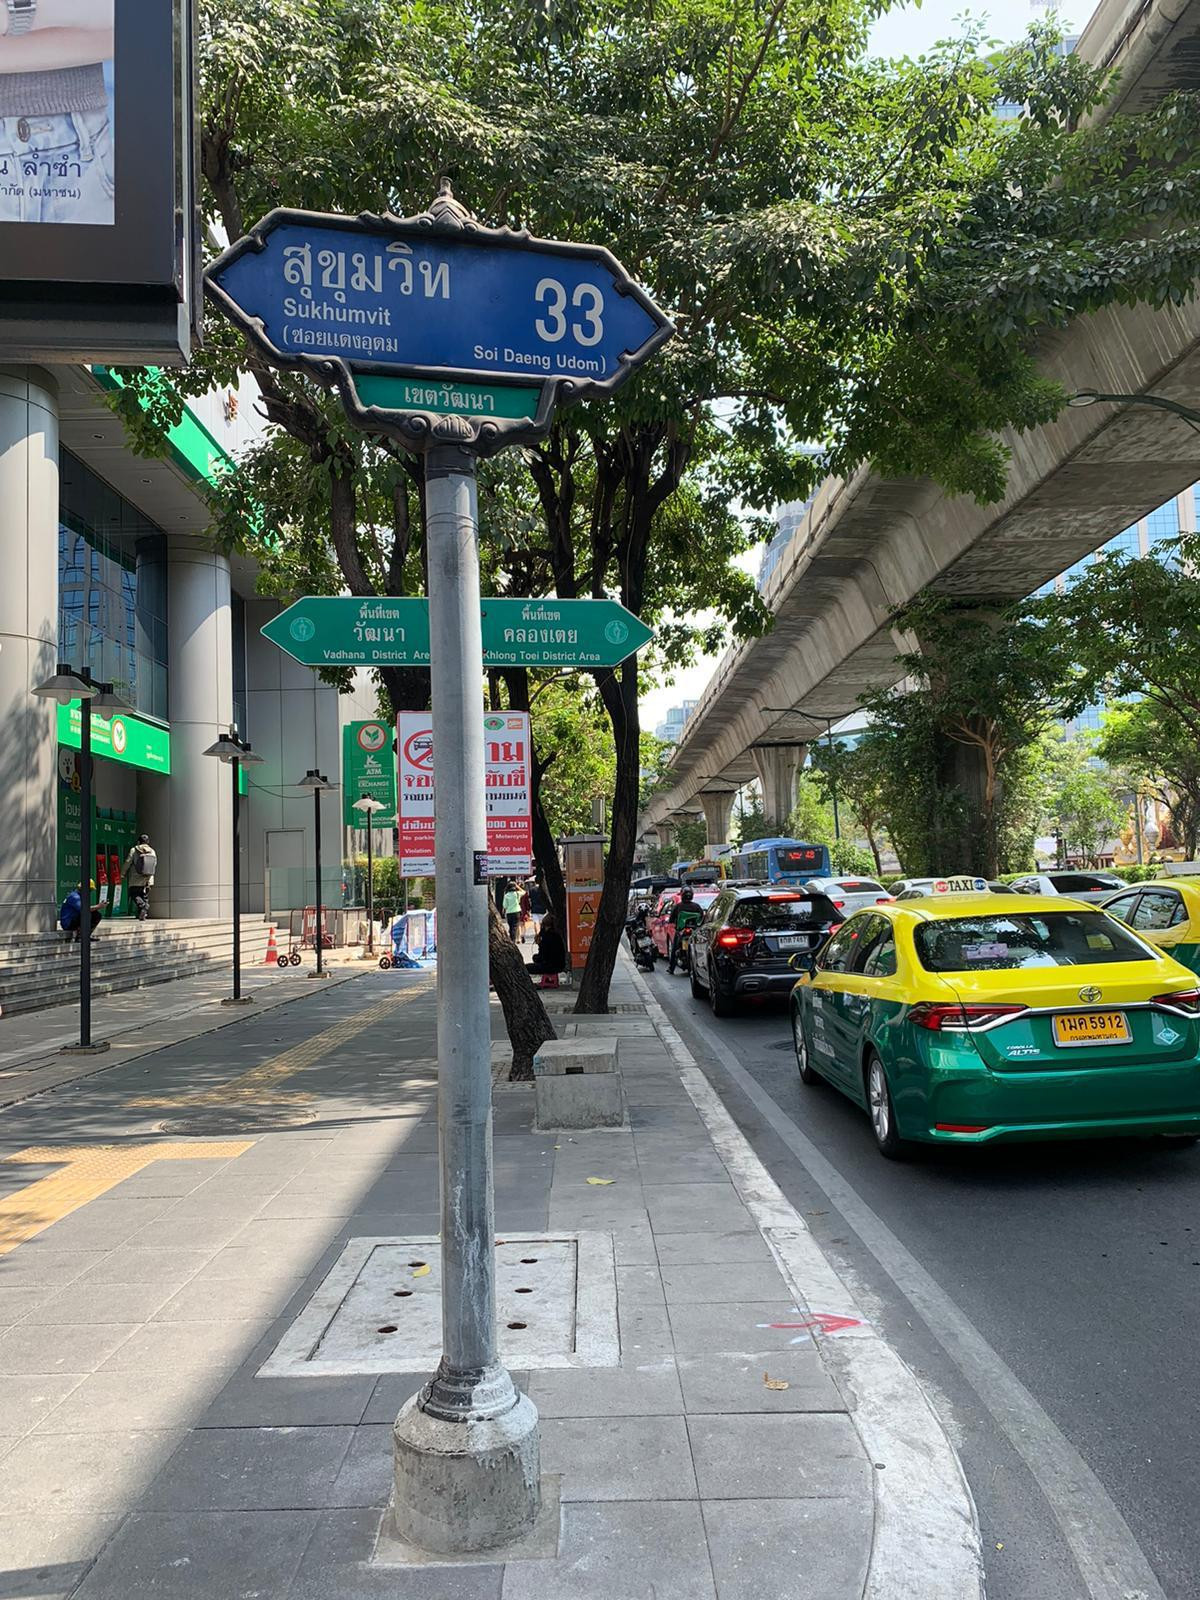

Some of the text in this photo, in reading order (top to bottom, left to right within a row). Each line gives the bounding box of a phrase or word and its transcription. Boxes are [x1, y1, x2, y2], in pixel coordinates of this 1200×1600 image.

[0, 183, 81, 199] ำกัด (มหาชน)
[283, 241, 450, 304] สุขุมวิท
[283, 298, 391, 326] Sukhumvit
[535, 277, 605, 347] 33
[473, 345, 607, 375] Soi Daeng Udom)
[404, 383, 495, 412] เขตวัฒนา
[359, 601, 400, 619] พื้นที่เขต
[521, 603, 561, 621] พื้นที่เขต
[353, 621, 405, 642] วัฒนา
[503, 628, 578, 644] คลองเตย
[323, 650, 430, 660] Vadhana District Are
[483, 651, 601, 662] Khlong Toei District Area
[948, 880, 974, 891] TAXI
[1089, 1015, 1123, 1029] 5912
[1008, 1049, 1040, 1057] ALTIS
